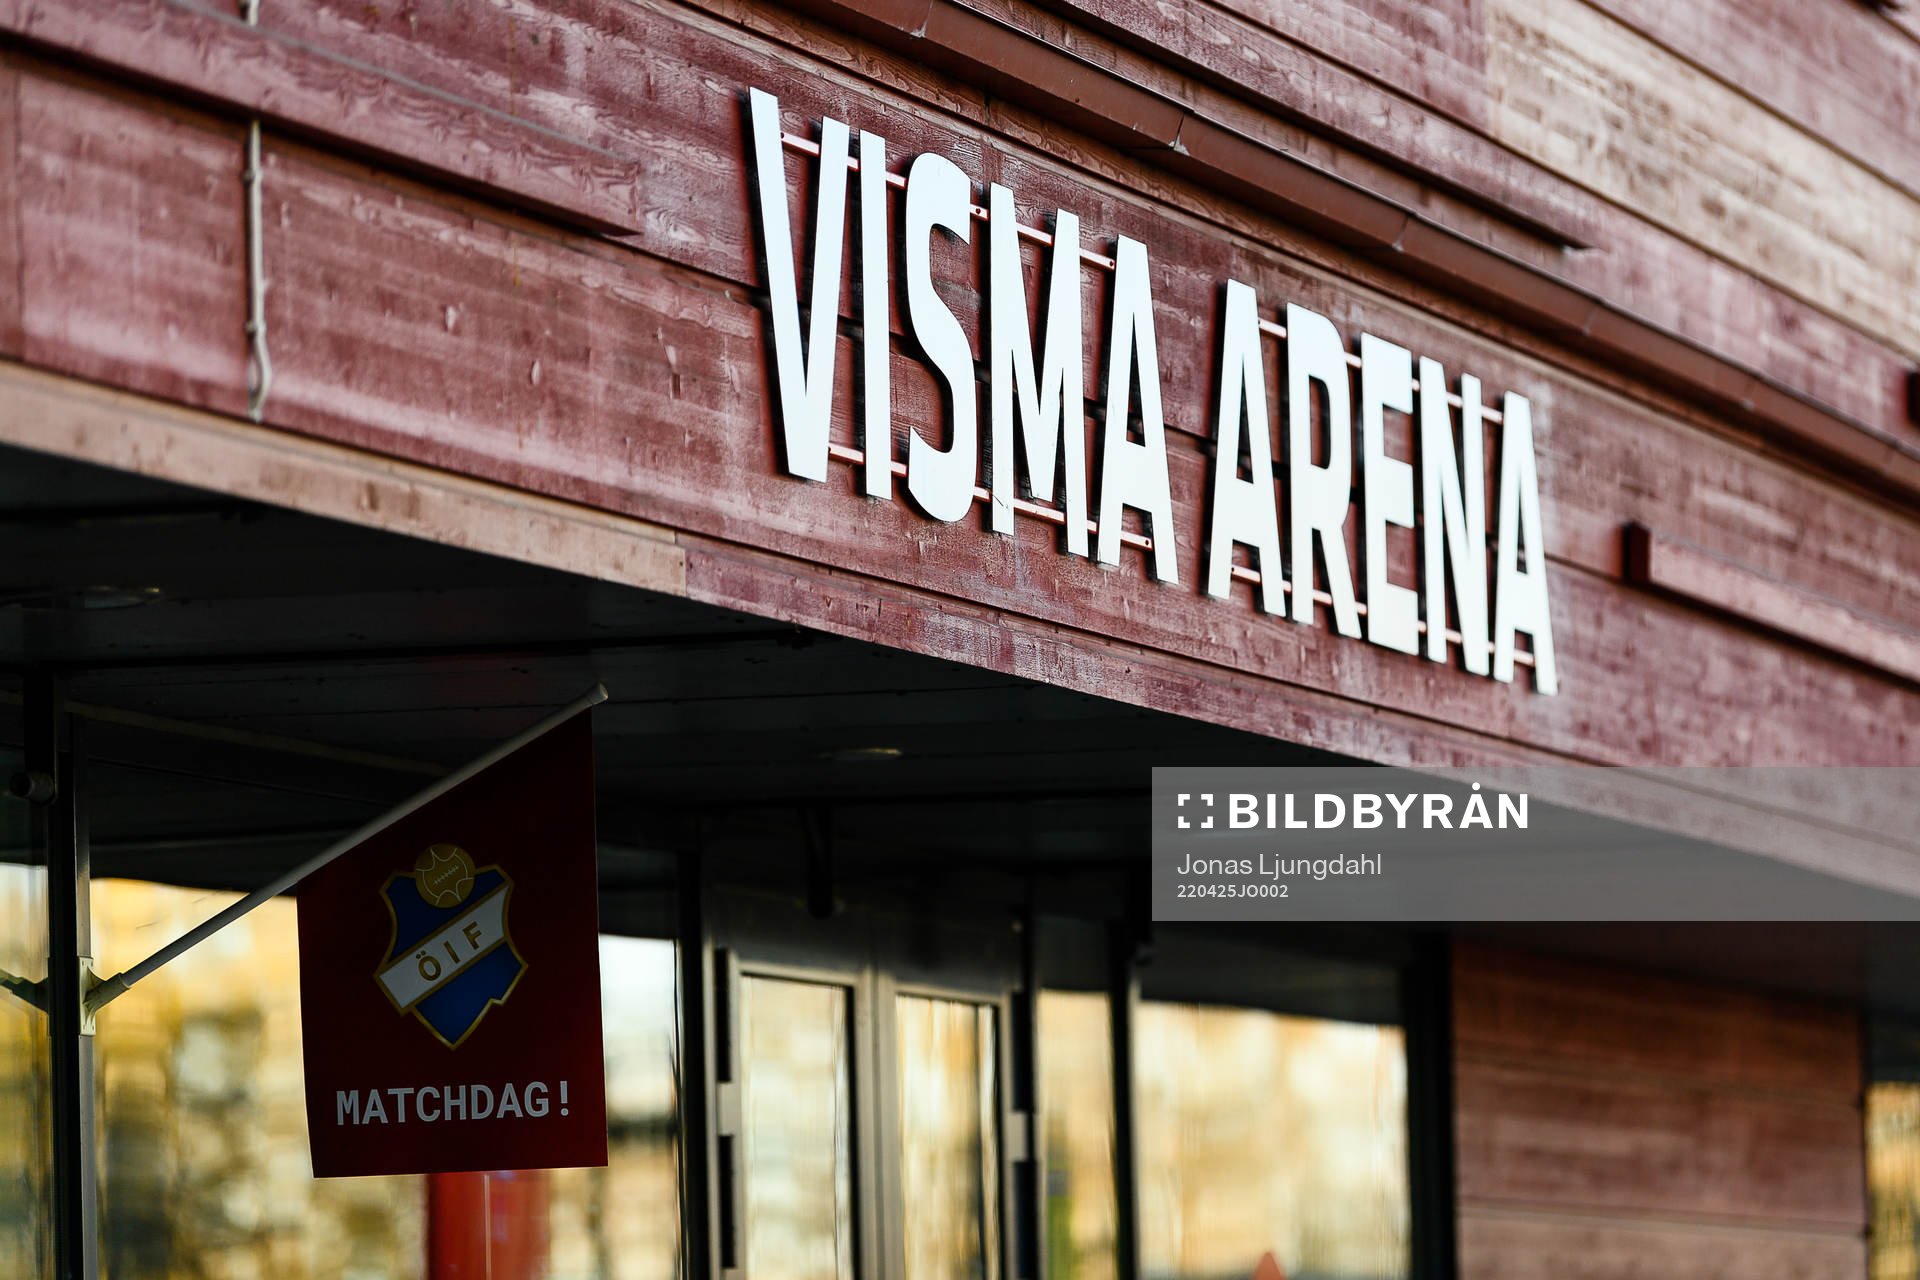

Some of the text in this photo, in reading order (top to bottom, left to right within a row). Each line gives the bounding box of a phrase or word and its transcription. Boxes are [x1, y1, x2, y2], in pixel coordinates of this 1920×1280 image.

[749, 86, 1559, 696] VISMA ARENA
[415, 921, 485, 983] ÖIF
[336, 1080, 570, 1126] MATCHDAG!
